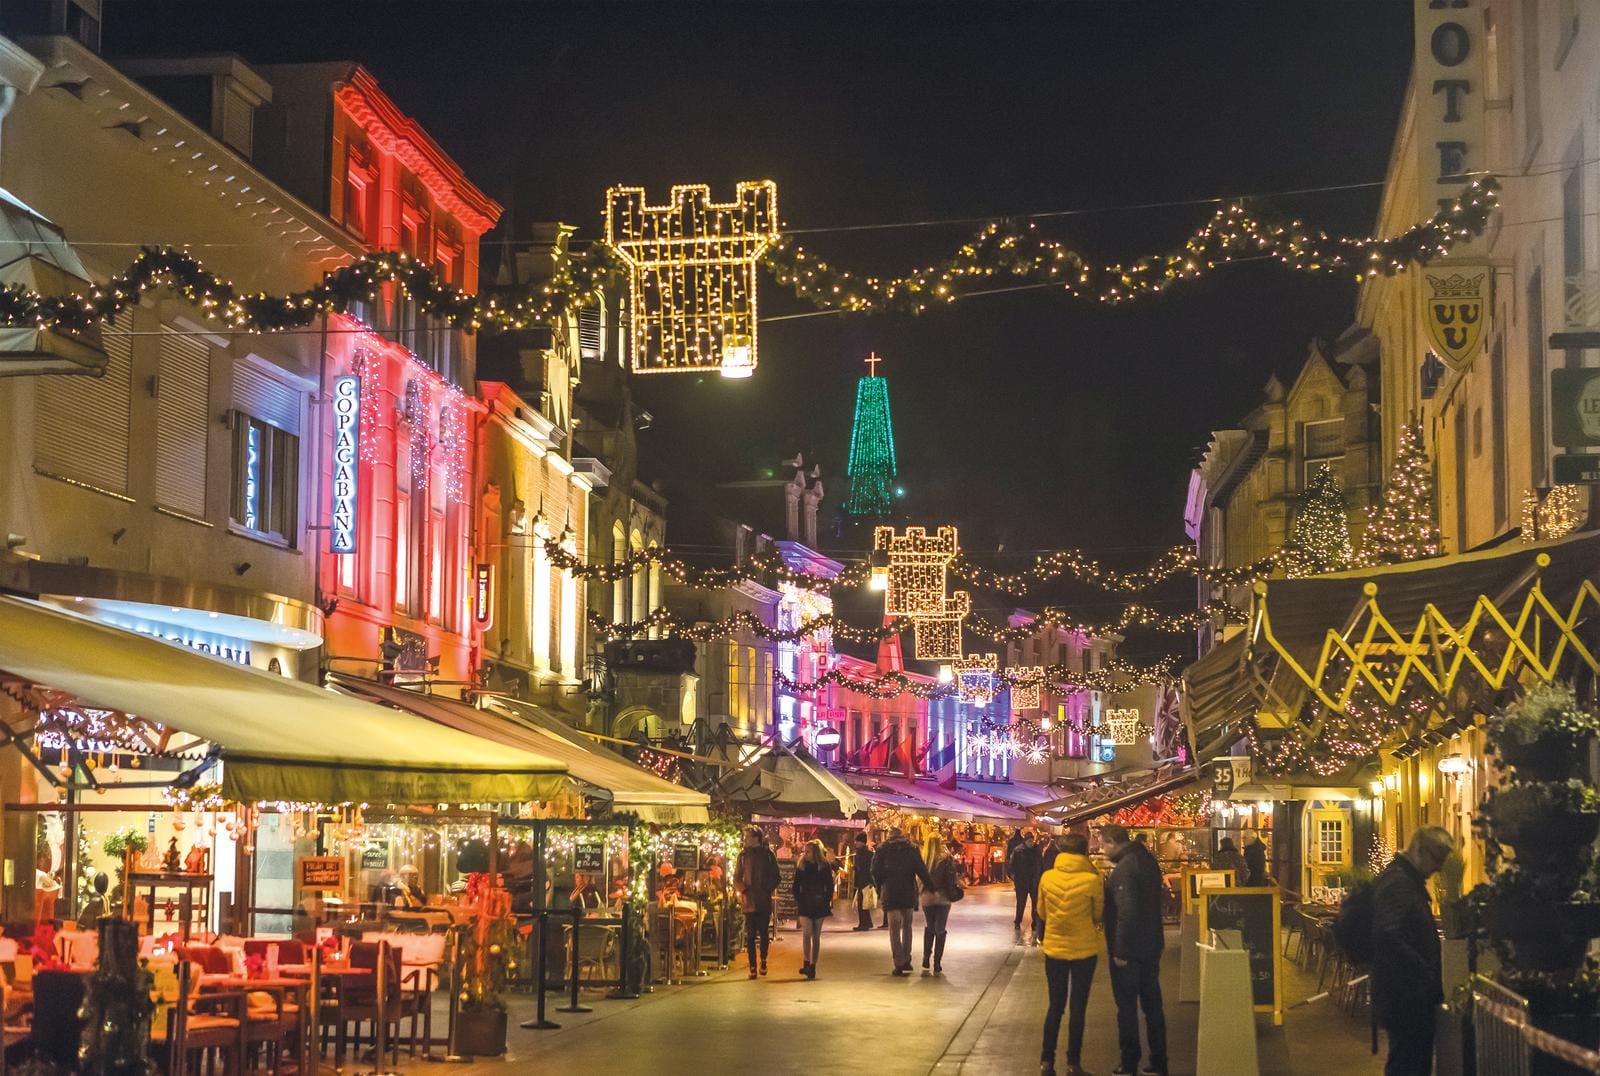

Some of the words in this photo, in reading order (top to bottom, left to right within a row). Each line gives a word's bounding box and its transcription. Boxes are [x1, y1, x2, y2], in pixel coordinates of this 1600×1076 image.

[1429, 0, 1471, 211] OTE
[334, 381, 352, 547] COPACABANA
[819, 641, 827, 706] HOTL
[1214, 768, 1231, 783] 35
